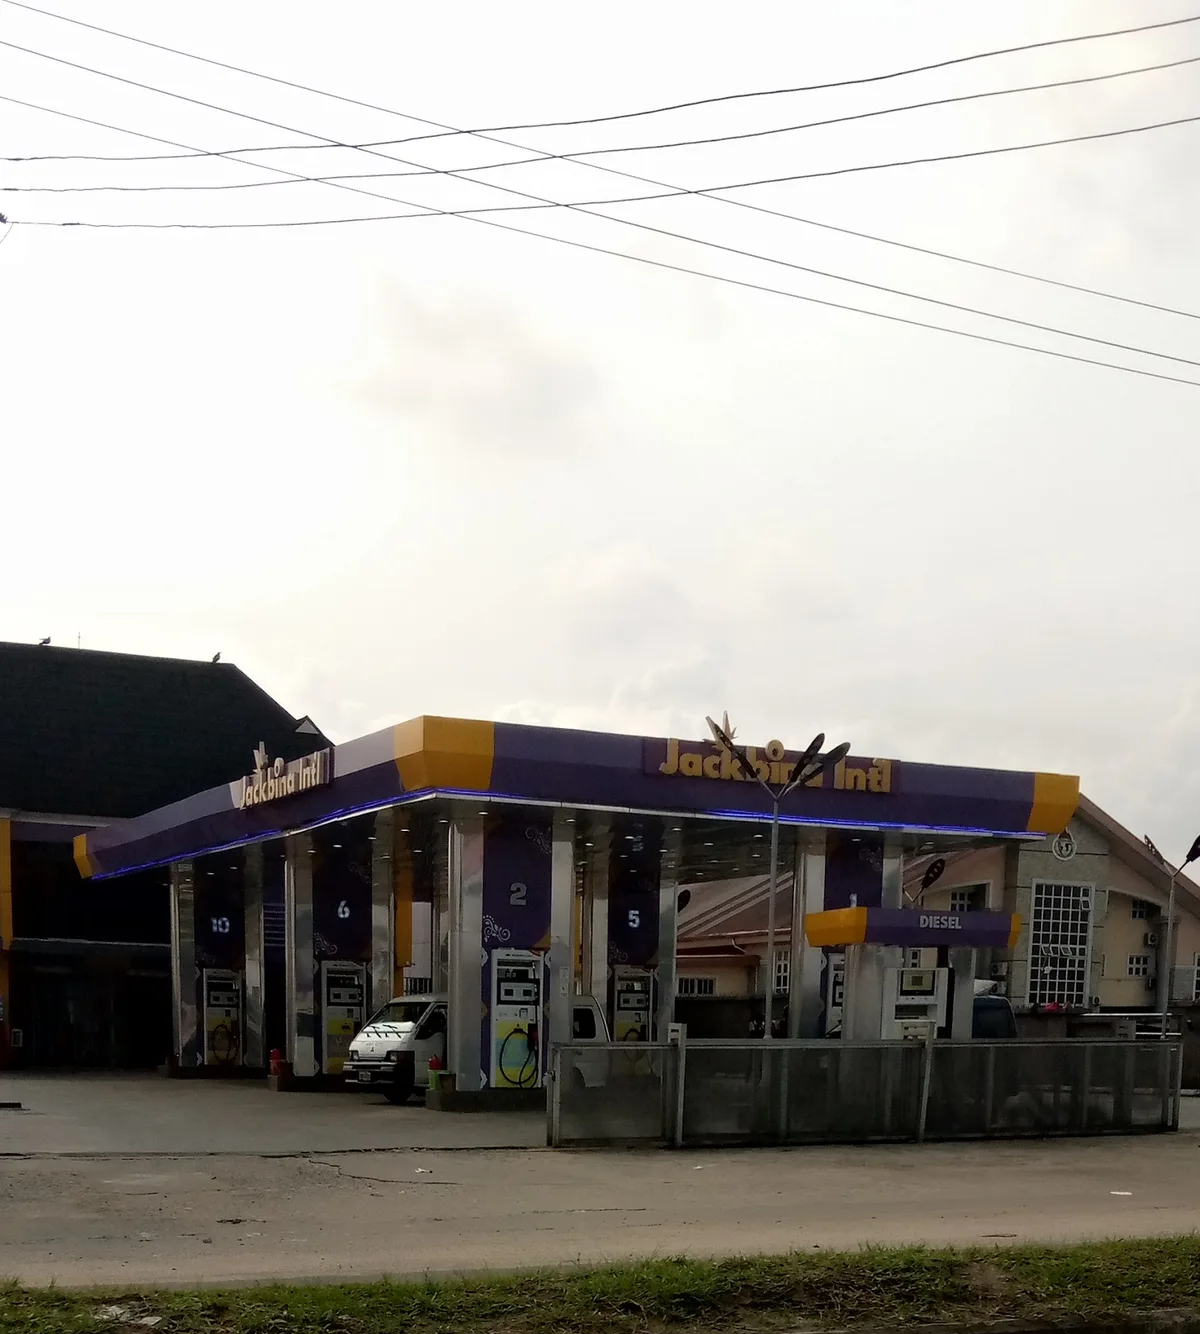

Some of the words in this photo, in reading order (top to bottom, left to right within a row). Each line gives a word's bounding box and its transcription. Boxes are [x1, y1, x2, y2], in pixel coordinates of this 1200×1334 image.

[239, 757, 296, 811] Jackbina
[509, 882, 527, 906] 2
[337, 900, 350, 919] 6
[211, 916, 230, 934] 10
[628, 910, 640, 928] 5
[919, 915, 962, 930] DIESEL
